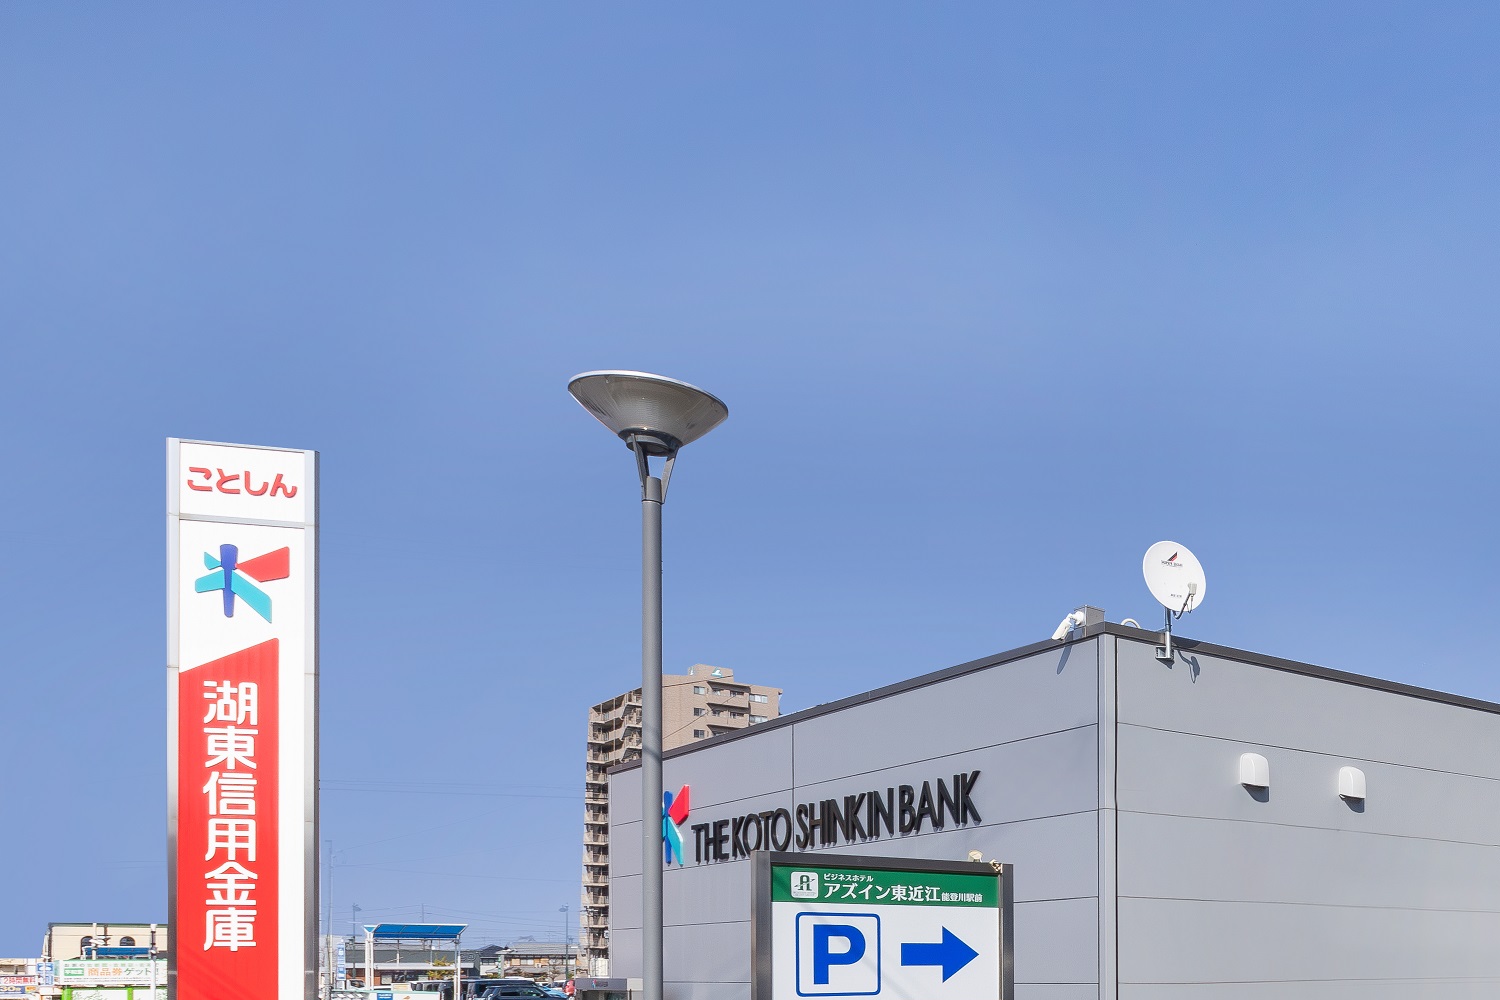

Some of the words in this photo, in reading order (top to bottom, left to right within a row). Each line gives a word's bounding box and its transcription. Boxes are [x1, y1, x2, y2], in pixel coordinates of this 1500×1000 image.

[187, 466, 298, 499] ことしん
[203, 680, 259, 952] 湖東信用金庫
[691, 819, 730, 865] THE
[731, 807, 792, 862] KOTO
[796, 787, 895, 852] SHINKIN
[898, 770, 982, 837] BANK
[823, 873, 874, 883] ビジネスホテル
[824, 882, 941, 902] アズイン東近江
[941, 892, 983, 903] 能登川駅前
[813, 924, 866, 985] P
